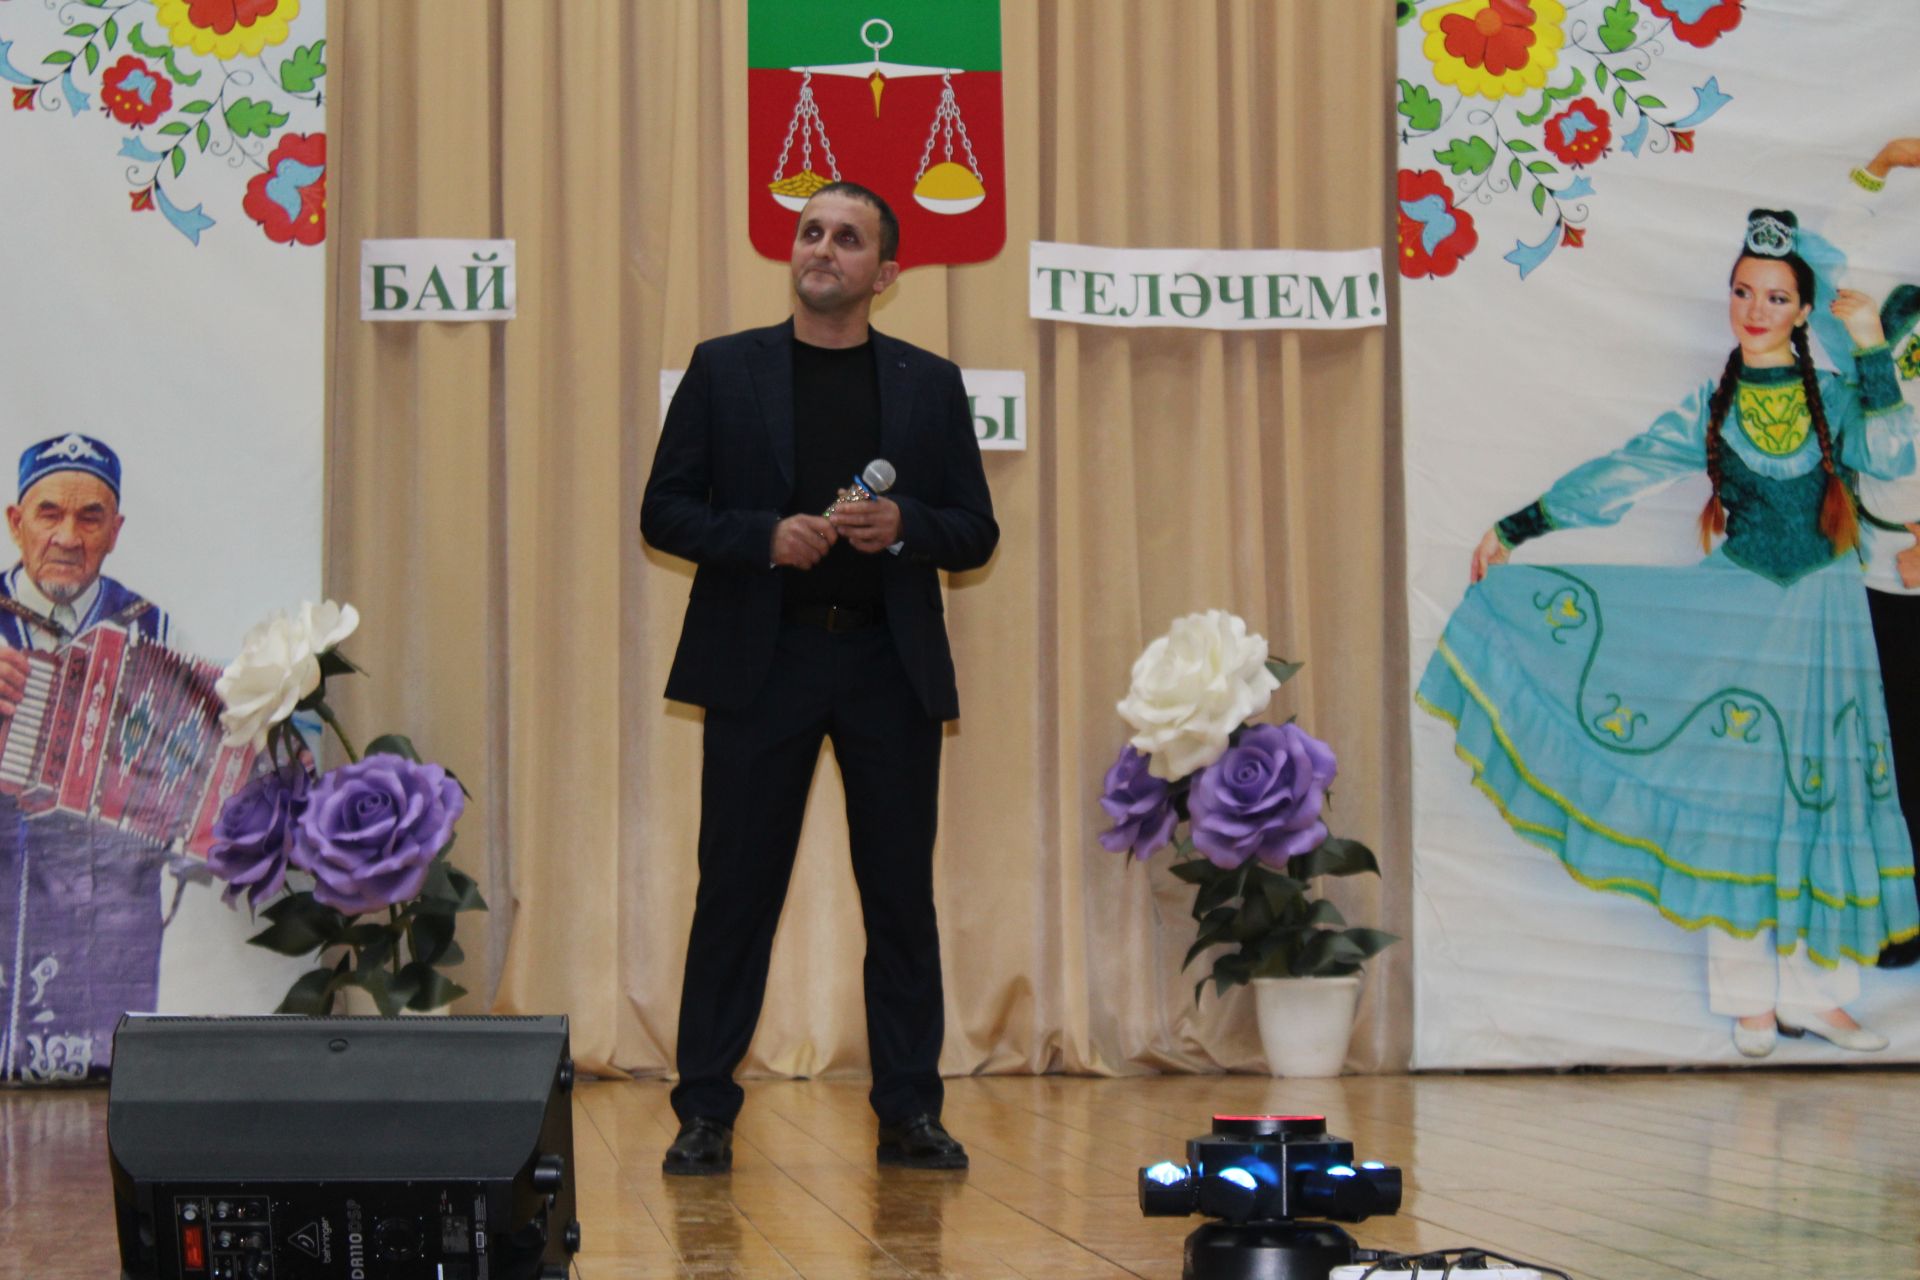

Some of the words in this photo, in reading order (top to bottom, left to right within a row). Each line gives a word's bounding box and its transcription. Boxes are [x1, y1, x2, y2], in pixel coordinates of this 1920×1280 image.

[368, 251, 511, 311] БАЙ
[1036, 266, 1382, 321] ТЕЛӘЧЕМ!
[321, 1216, 332, 1264] behringer
